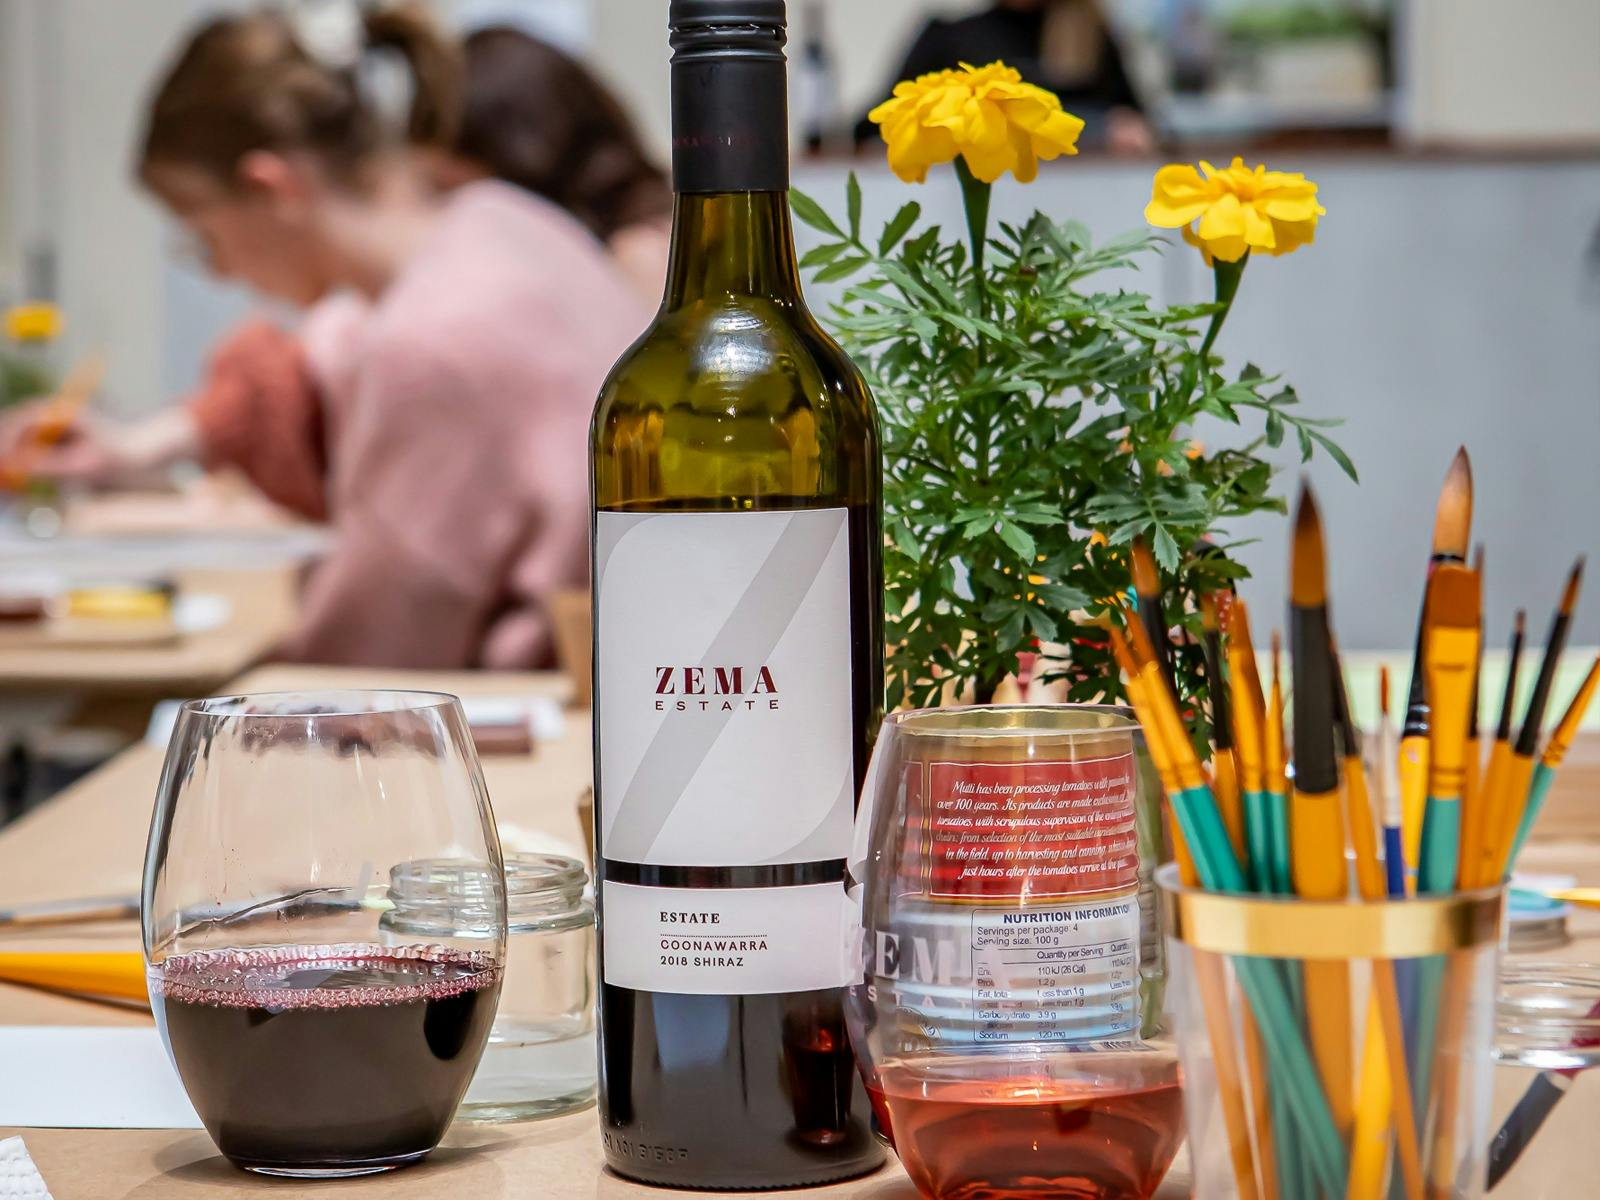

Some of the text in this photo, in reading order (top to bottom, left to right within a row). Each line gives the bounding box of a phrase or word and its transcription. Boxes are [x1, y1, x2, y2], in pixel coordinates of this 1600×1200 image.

[655, 665, 778, 695] ZEMA
[655, 699, 779, 711] ESTATE
[976, 782, 992, 794] has
[993, 782, 1013, 794] been
[1013, 782, 1060, 797] processing
[954, 798, 973, 810] 100
[1017, 797, 1055, 813] products
[1057, 799, 1070, 809] are
[975, 815, 993, 827] with
[994, 814, 1041, 829] scrupulous
[1042, 813, 1086, 829] supervision
[960, 831, 980, 844] from
[981, 831, 1018, 843] selection
[1019, 830, 1029, 845] of
[1029, 831, 1043, 842] the
[1043, 832, 1065, 842] most
[946, 848, 955, 859] in
[956, 847, 968, 859] the
[992, 851, 1004, 863] up
[1005, 848, 1014, 860] to
[1015, 847, 1060, 862] harvesting
[1062, 845, 1078, 858] and
[957, 865, 978, 880] just
[978, 865, 1004, 876] hours
[1006, 865, 1027, 878] after
[1027, 864, 1041, 876] the
[1042, 864, 1078, 876] tomatoes
[660, 911, 720, 924] ESTATE
[1003, 911, 1072, 924] NUTRITION
[977, 926, 1015, 937] Servings
[1017, 927, 1031, 937] per
[660, 939, 768, 951] COONAWARRA
[977, 937, 1010, 947] Serving
[1036, 936, 1051, 945] 100
[1053, 937, 1059, 946] g
[660, 955, 744, 967] 2018 SHIRAZ
[1037, 950, 1066, 960] Quantity
[1067, 950, 1079, 959] per
[1051, 966, 1060, 975] kJ
[1072, 964, 1086, 975] Cal)
[993, 990, 1008, 998] tota
[978, 1010, 1030, 1020] Carboydrate
[979, 1031, 1009, 1039] Sodium
